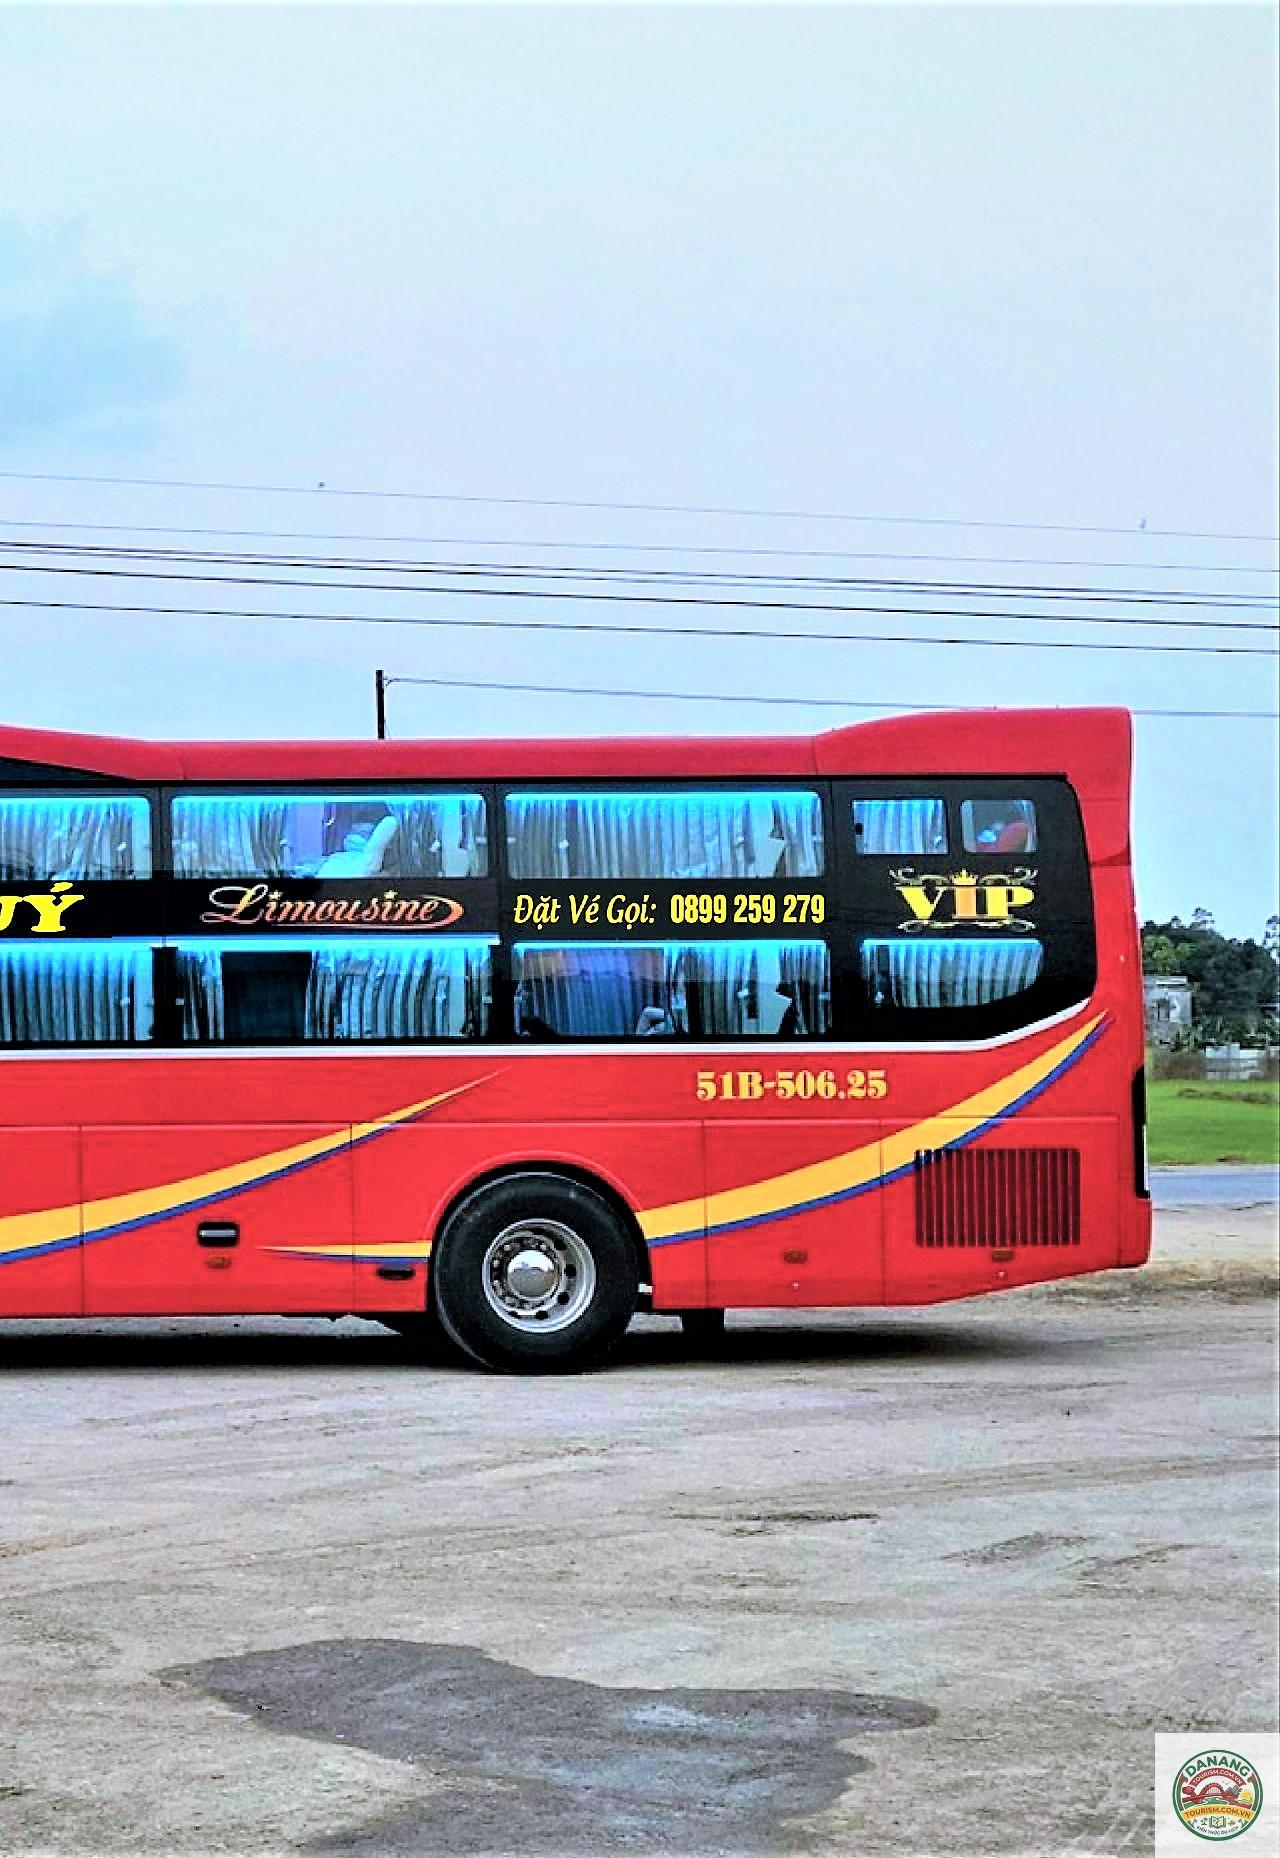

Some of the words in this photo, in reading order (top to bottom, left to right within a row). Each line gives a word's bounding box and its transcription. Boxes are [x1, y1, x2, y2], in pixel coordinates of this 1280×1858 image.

[200, 884, 463, 929] Limousine
[513, 895, 561, 930] Đặt
[569, 895, 600, 923] Vé
[607, 894, 657, 930] Gọi:
[670, 894, 727, 923] 0899
[733, 894, 775, 923] 259
[782, 894, 825, 923] 279
[896, 886, 1035, 919] VIP
[696, 1070, 887, 1099] 51B-506.25
